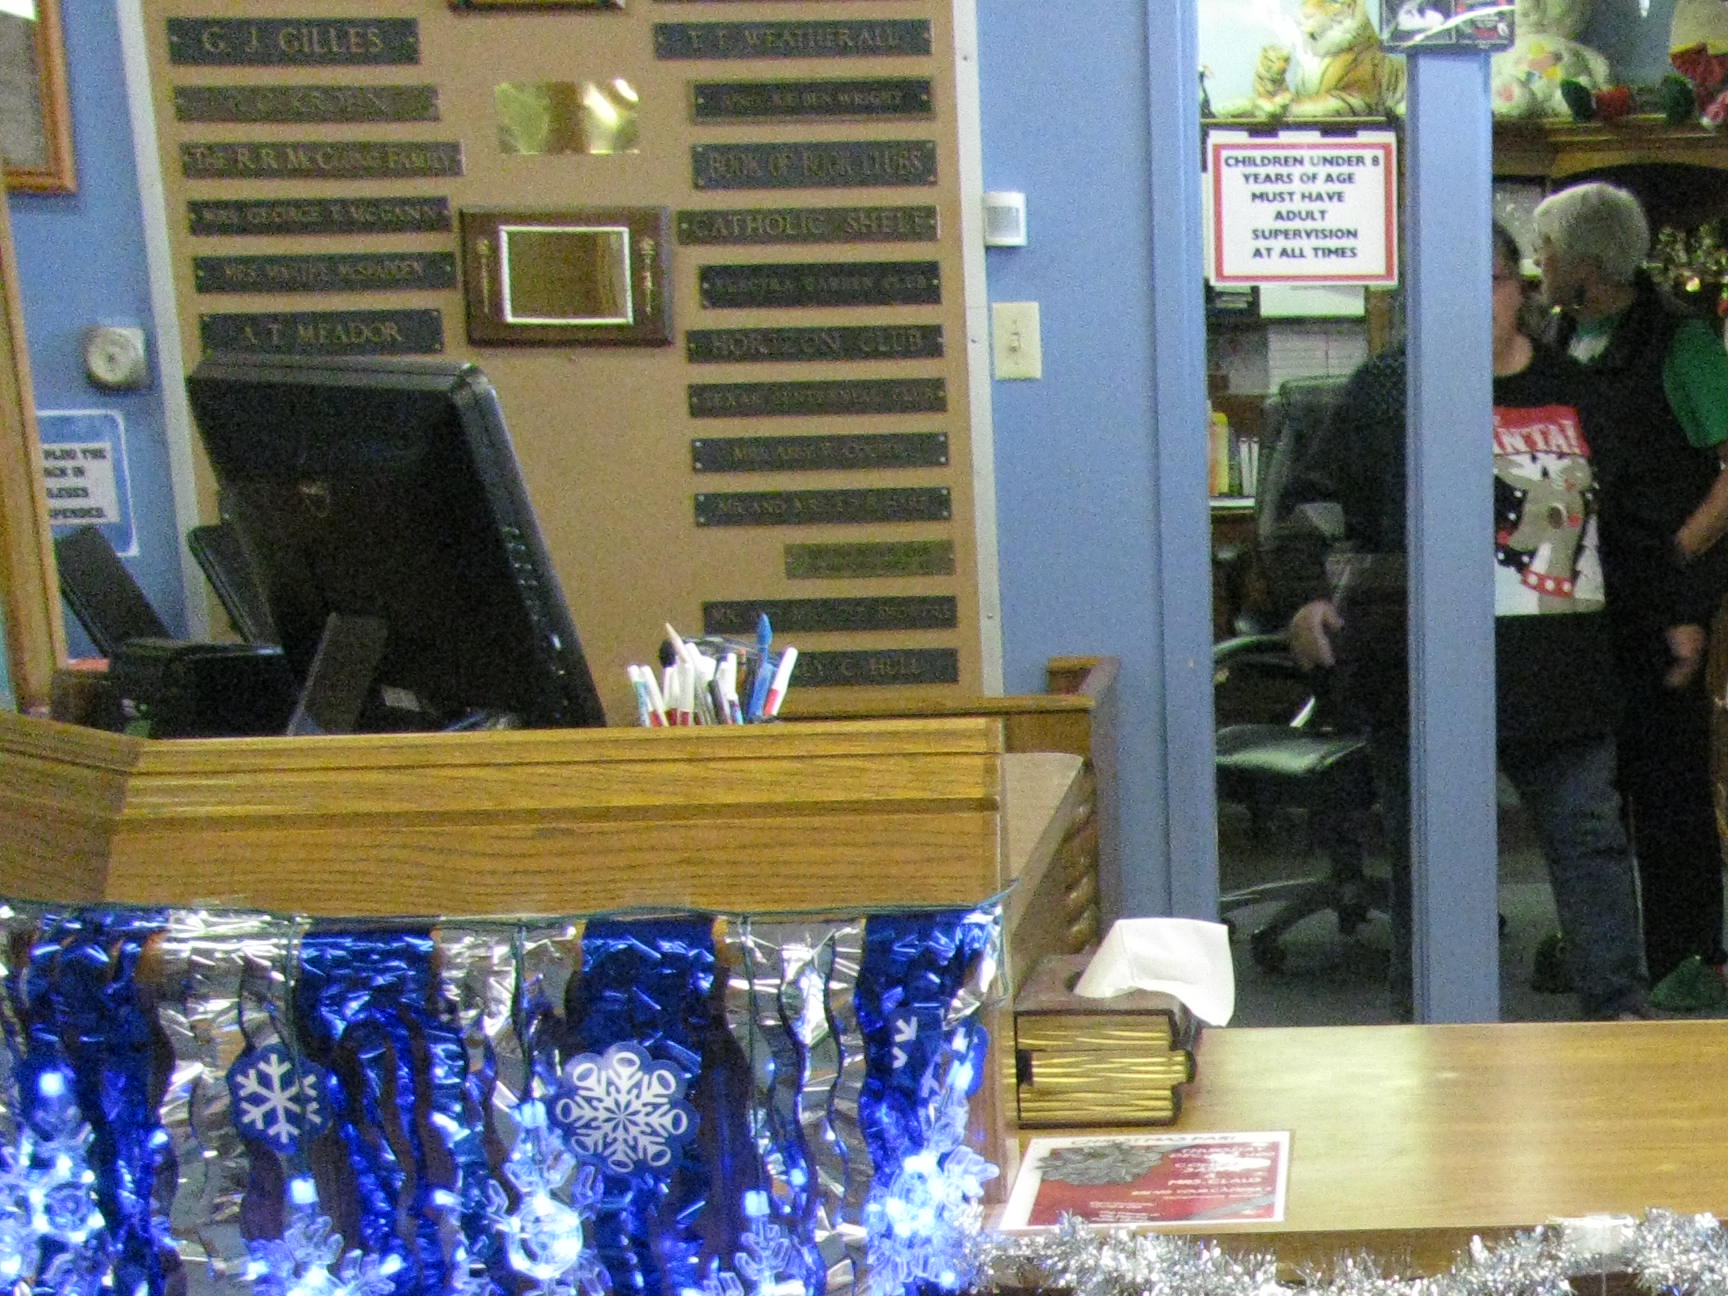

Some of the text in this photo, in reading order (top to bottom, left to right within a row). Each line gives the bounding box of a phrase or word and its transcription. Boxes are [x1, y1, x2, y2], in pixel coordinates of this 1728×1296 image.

[277, 25, 384, 54] GILLES
[1224, 155, 1380, 168] CHILDREN UNDER 8
[1242, 172, 1356, 184] YEARS OF AGE
[1250, 191, 1346, 203] MUST HAVE
[1273, 210, 1329, 221] ADULT
[691, 213, 827, 238] CATHOLIC
[1251, 228, 1358, 240] SUPERVISION
[1251, 247, 1358, 259] AT ALL TIMES
[295, 320, 405, 345] MEADOR
